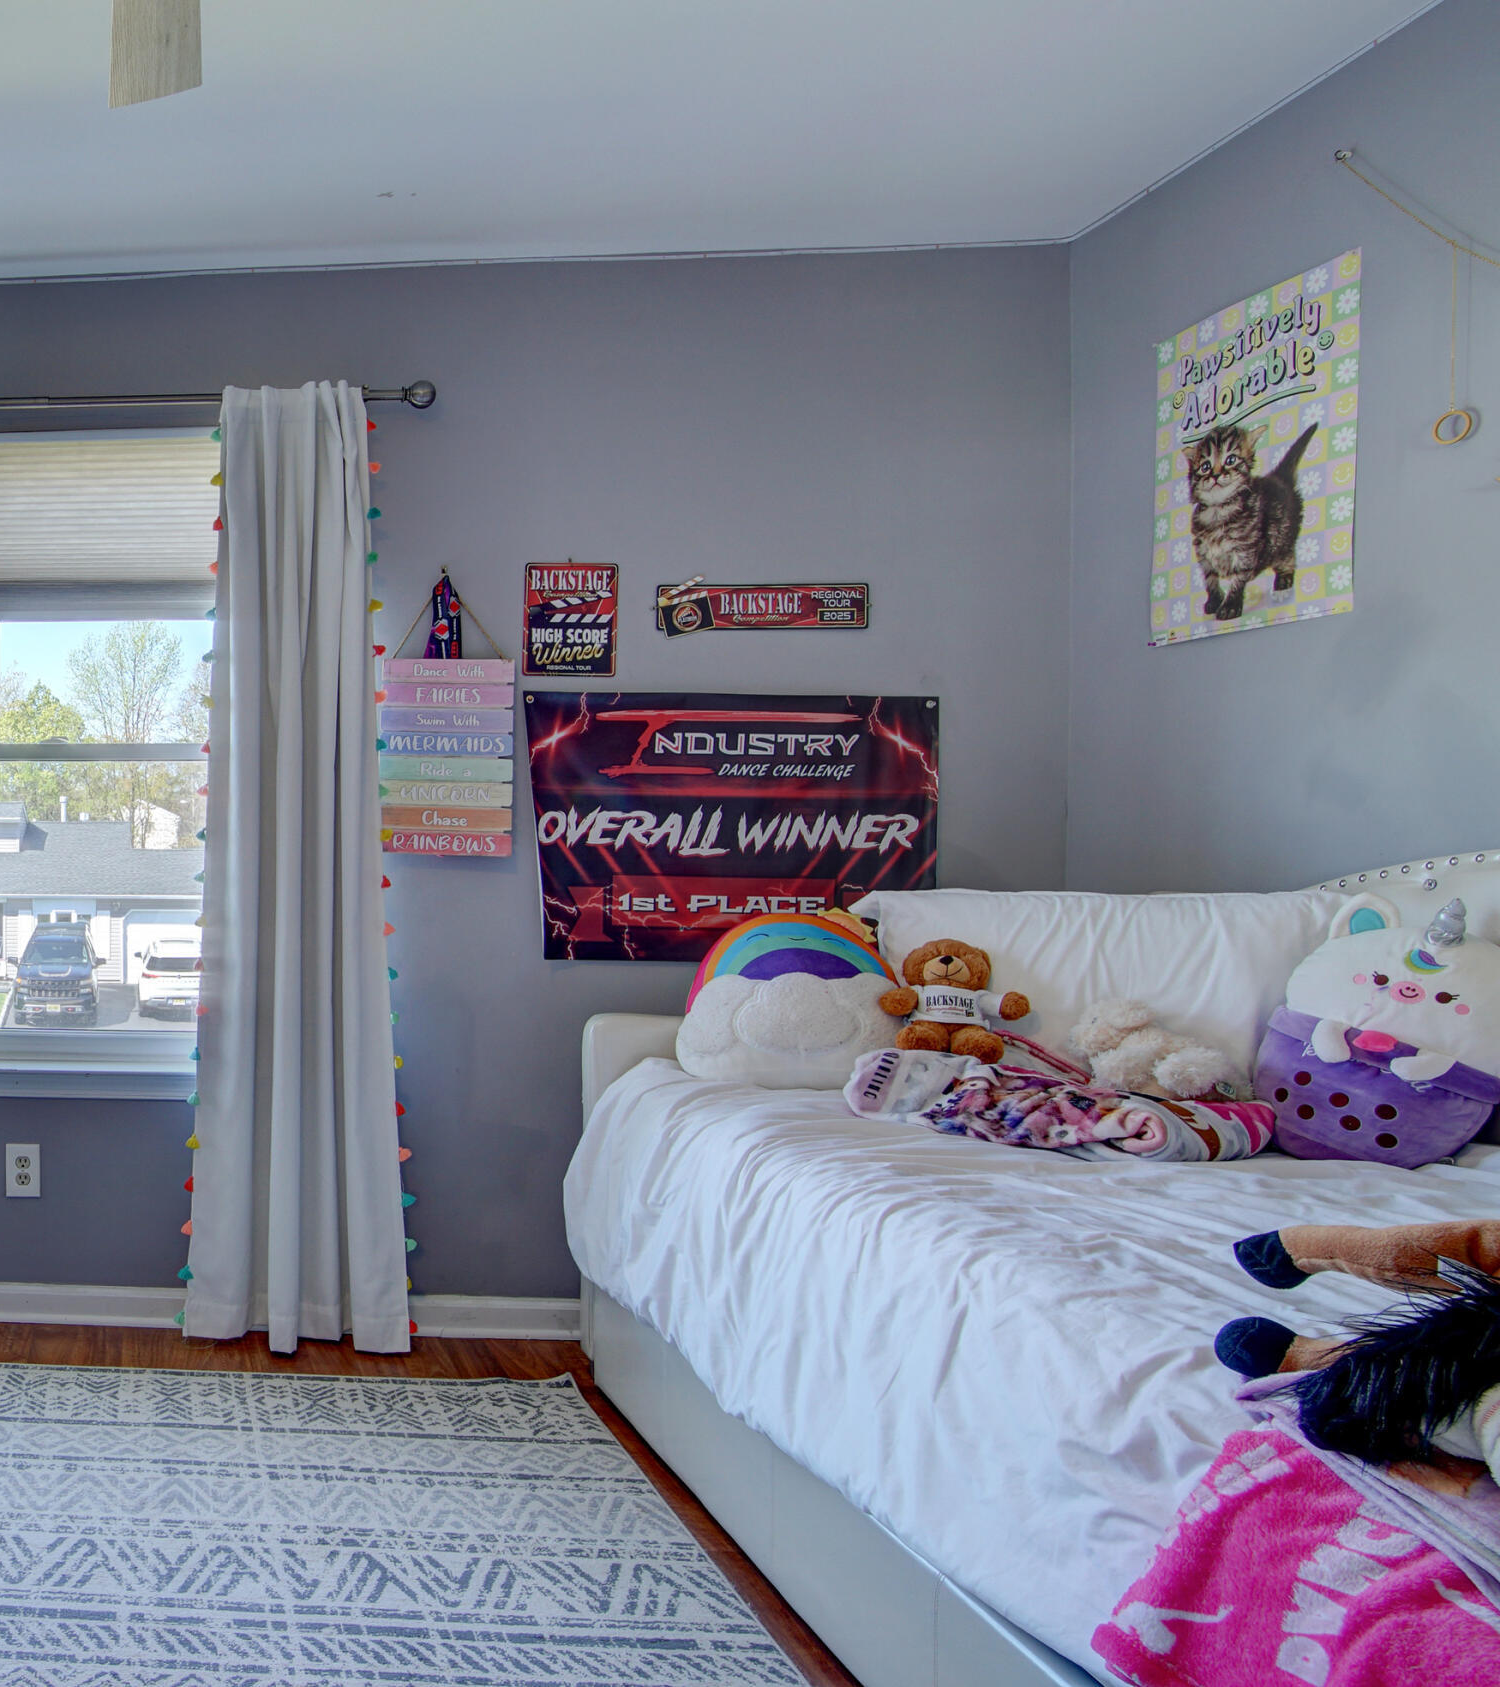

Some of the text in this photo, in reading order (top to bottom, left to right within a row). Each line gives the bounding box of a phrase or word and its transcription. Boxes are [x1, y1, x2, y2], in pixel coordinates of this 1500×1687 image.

[1180, 294, 1321, 387] Pawsitively
[1181, 338, 1316, 431] Adorable
[531, 569, 611, 591] BACKSTAGE
[811, 590, 863, 600] REGIONAL
[823, 599, 850, 607] TOUR
[719, 593, 802, 615] BACKSTAGE
[732, 614, 790, 624] Competition
[823, 612, 851, 621] 2025
[531, 627, 610, 644] HIGH SCORE
[531, 640, 605, 665] Winner
[413, 663, 485, 678] Dance With
[415, 687, 481, 703] FAIRIES
[416, 713, 480, 727] Swim With
[389, 735, 505, 752] MERMAIDS
[595, 709, 862, 779] INDUSTRY
[420, 762, 472, 777] Ride a
[717, 763, 857, 780] DANCE CHALLENGE
[400, 784, 490, 802] UNICORN
[421, 810, 468, 827] Chase
[537, 804, 920, 858] OVERALL WINNER
[392, 833, 497, 853] RAINBOWS
[618, 893, 826, 915] 1st PLACE
[925, 994, 975, 1011] BACKSTAGE
